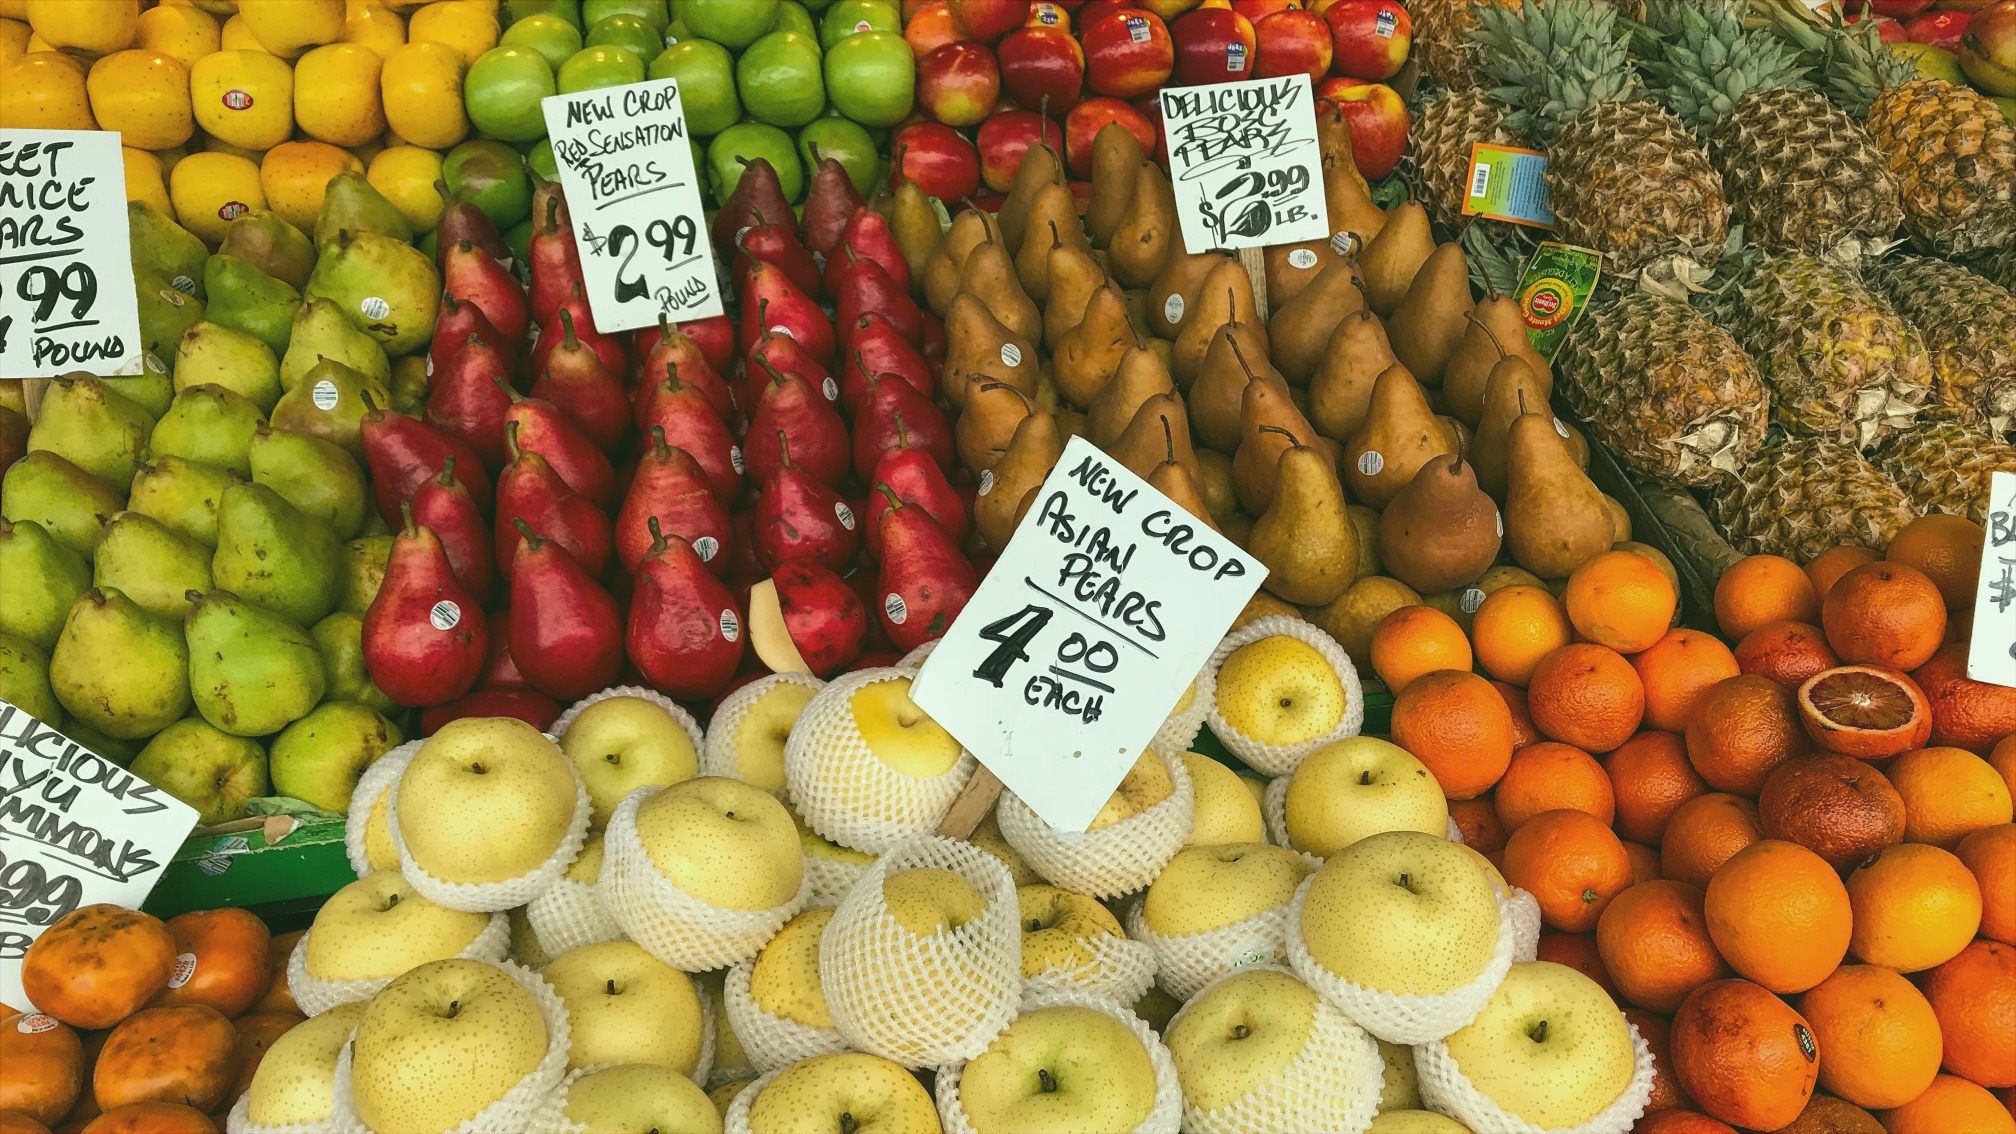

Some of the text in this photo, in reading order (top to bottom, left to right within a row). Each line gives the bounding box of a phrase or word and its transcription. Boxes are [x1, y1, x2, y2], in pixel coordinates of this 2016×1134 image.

[567, 85, 676, 128] NEW CROP
[1162, 78, 1303, 119] DELICIOUS
[554, 117, 683, 168] RED SENSATION
[1173, 105, 1281, 143] BOSC
[1173, 119, 1292, 167] PEARS
[581, 161, 667, 200] PEARS
[1274, 205, 1318, 226] LB.
[654, 276, 707, 315] POUND
[33, 335, 125, 368] POUND
[1036, 490, 1137, 573] ASIAN
[1068, 455, 1245, 581] NEW CROP
[1058, 552, 1167, 642] PEARS
[1024, 674, 1104, 725] EACH
[0, 698, 169, 815] LICIOUS
